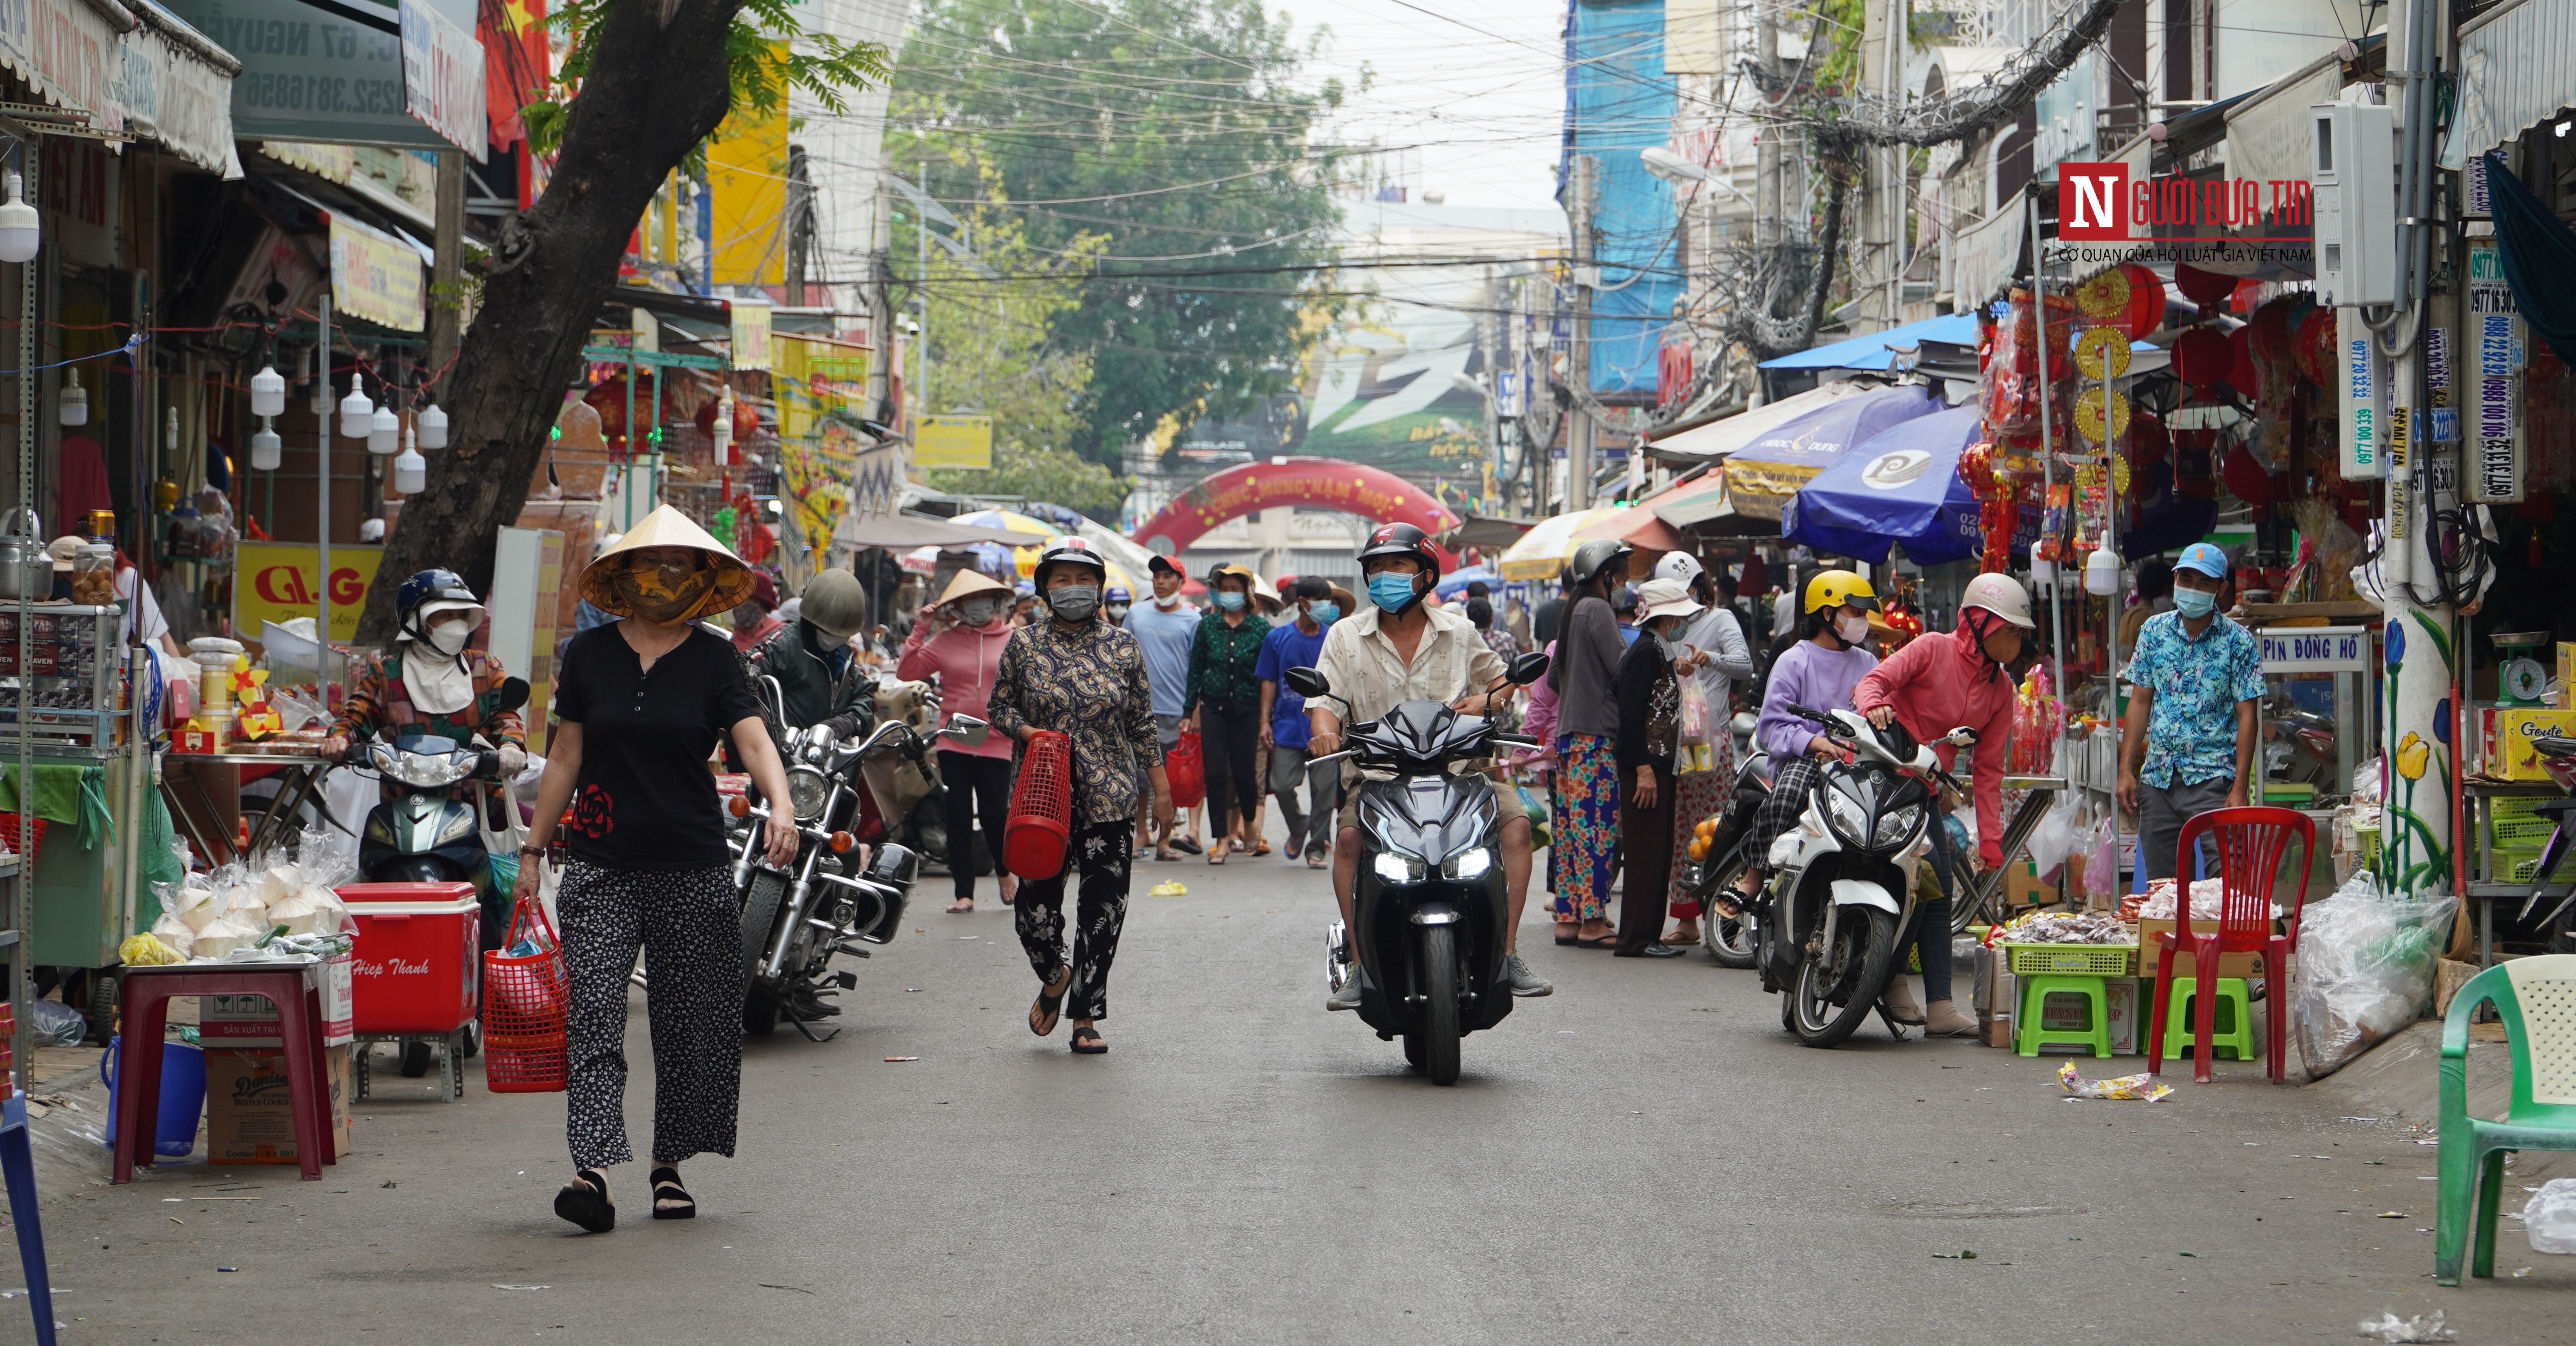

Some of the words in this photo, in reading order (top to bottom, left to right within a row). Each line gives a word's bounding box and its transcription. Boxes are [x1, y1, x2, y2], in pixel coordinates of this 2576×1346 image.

[2472, 289, 2521, 313] 0977.16.30.3
[2483, 316, 2509, 374] 0988.22.92.92
[2481, 378, 2507, 438] 0988.100.106
[2357, 408, 2372, 464] 0977.100.339
[2486, 439, 2512, 495] 0977.31.31.32
[2295, 634, 2331, 659] ĐỒNG
[2340, 634, 2359, 659] HỒ
[2521, 722, 2563, 737] Gouté
[388, 958, 429, 976] Thanh
[224, 1024, 239, 1034] SẢN
[242, 1024, 261, 1034] XUẤT
[263, 1026, 276, 1035] TẠI
